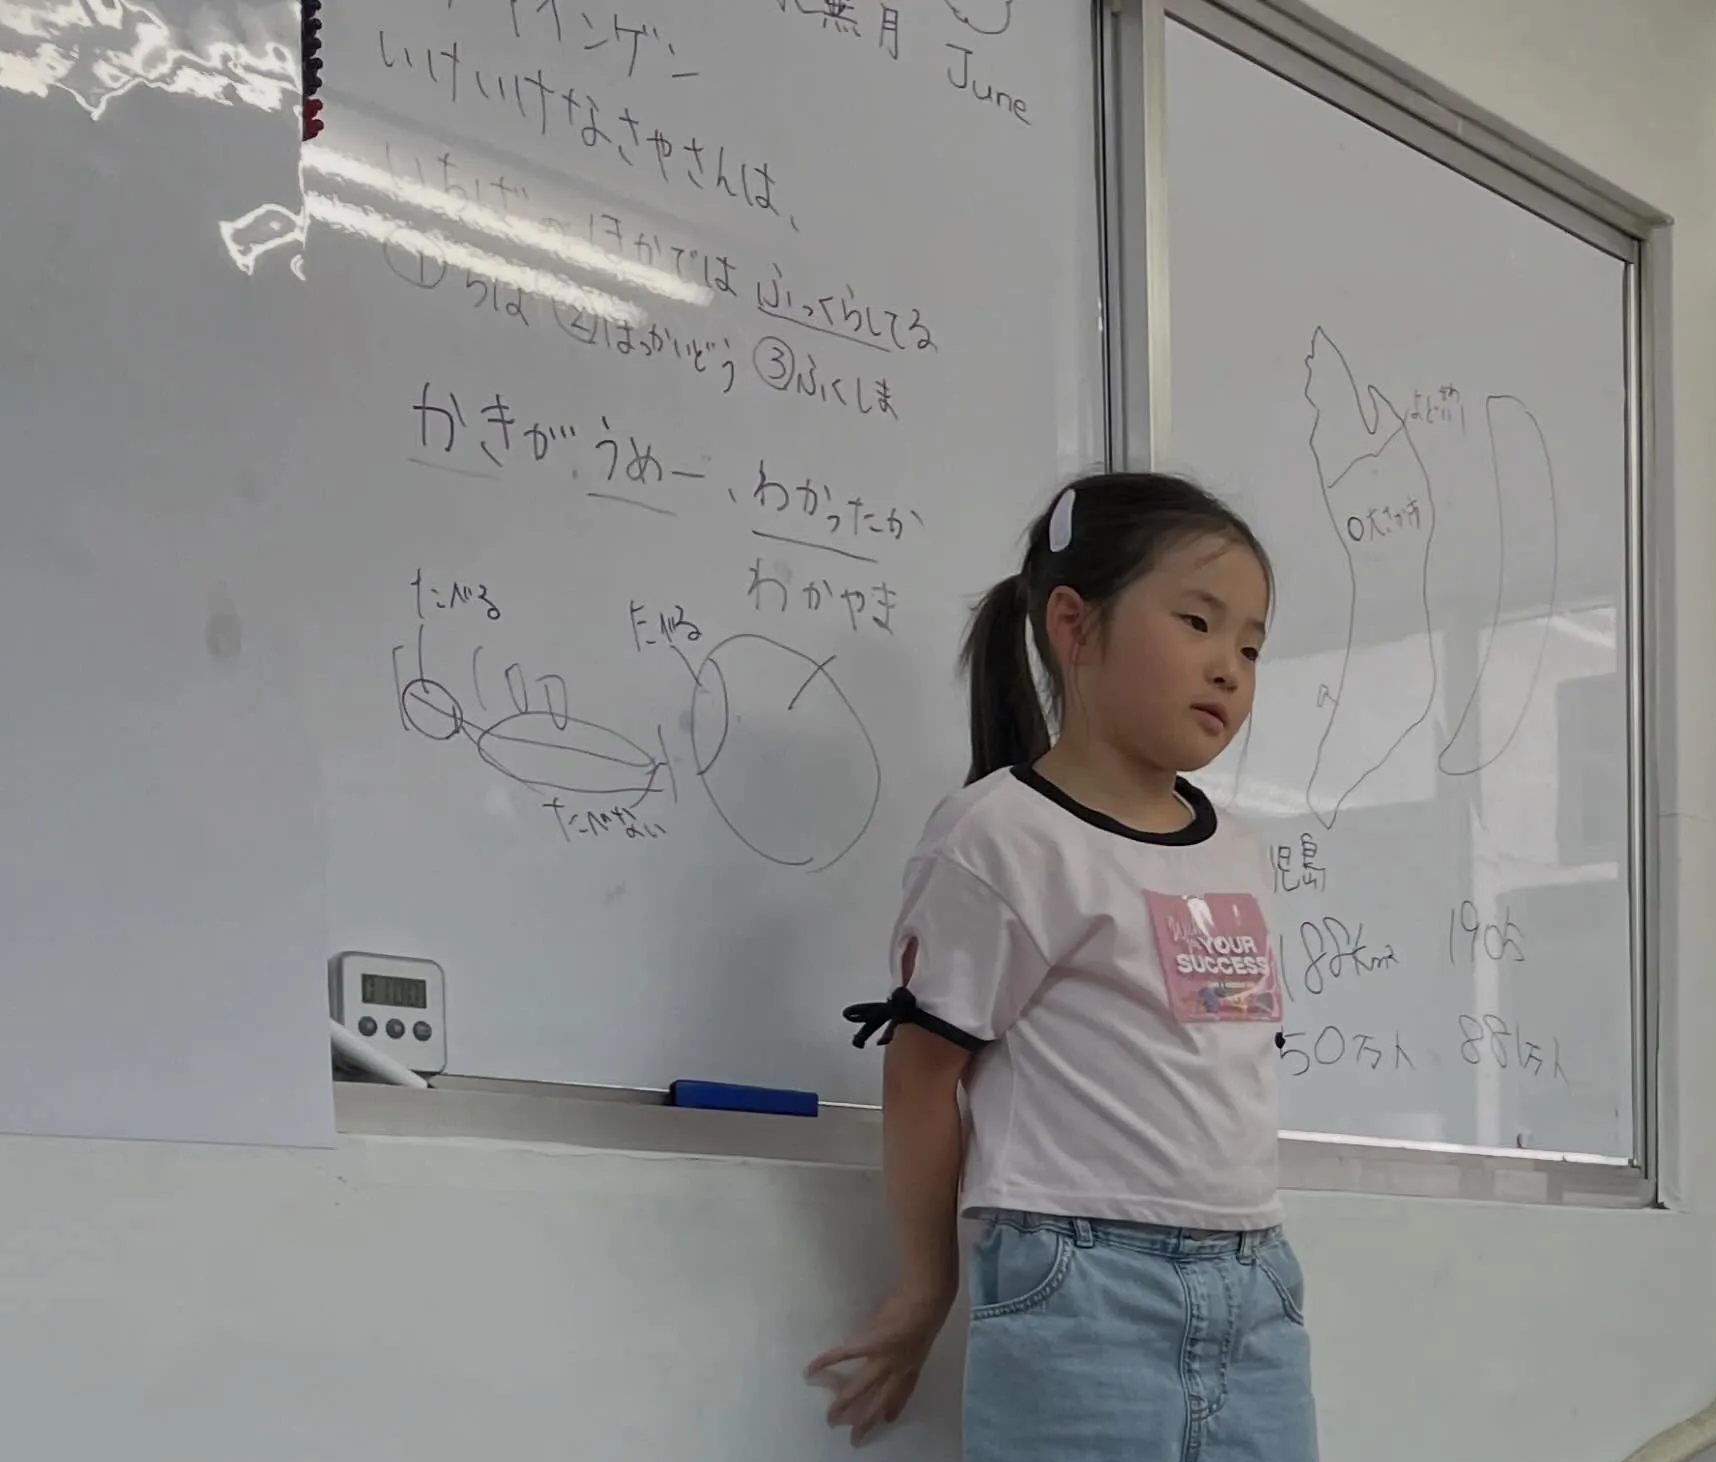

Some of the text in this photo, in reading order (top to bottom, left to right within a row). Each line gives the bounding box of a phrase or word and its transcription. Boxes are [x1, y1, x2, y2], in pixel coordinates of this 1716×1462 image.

[945, 43, 1031, 126] June
[749, 558, 896, 634] わかやま
[1177, 953, 1270, 975] SUCCESS
[1199, 935, 1258, 955] YOUR
